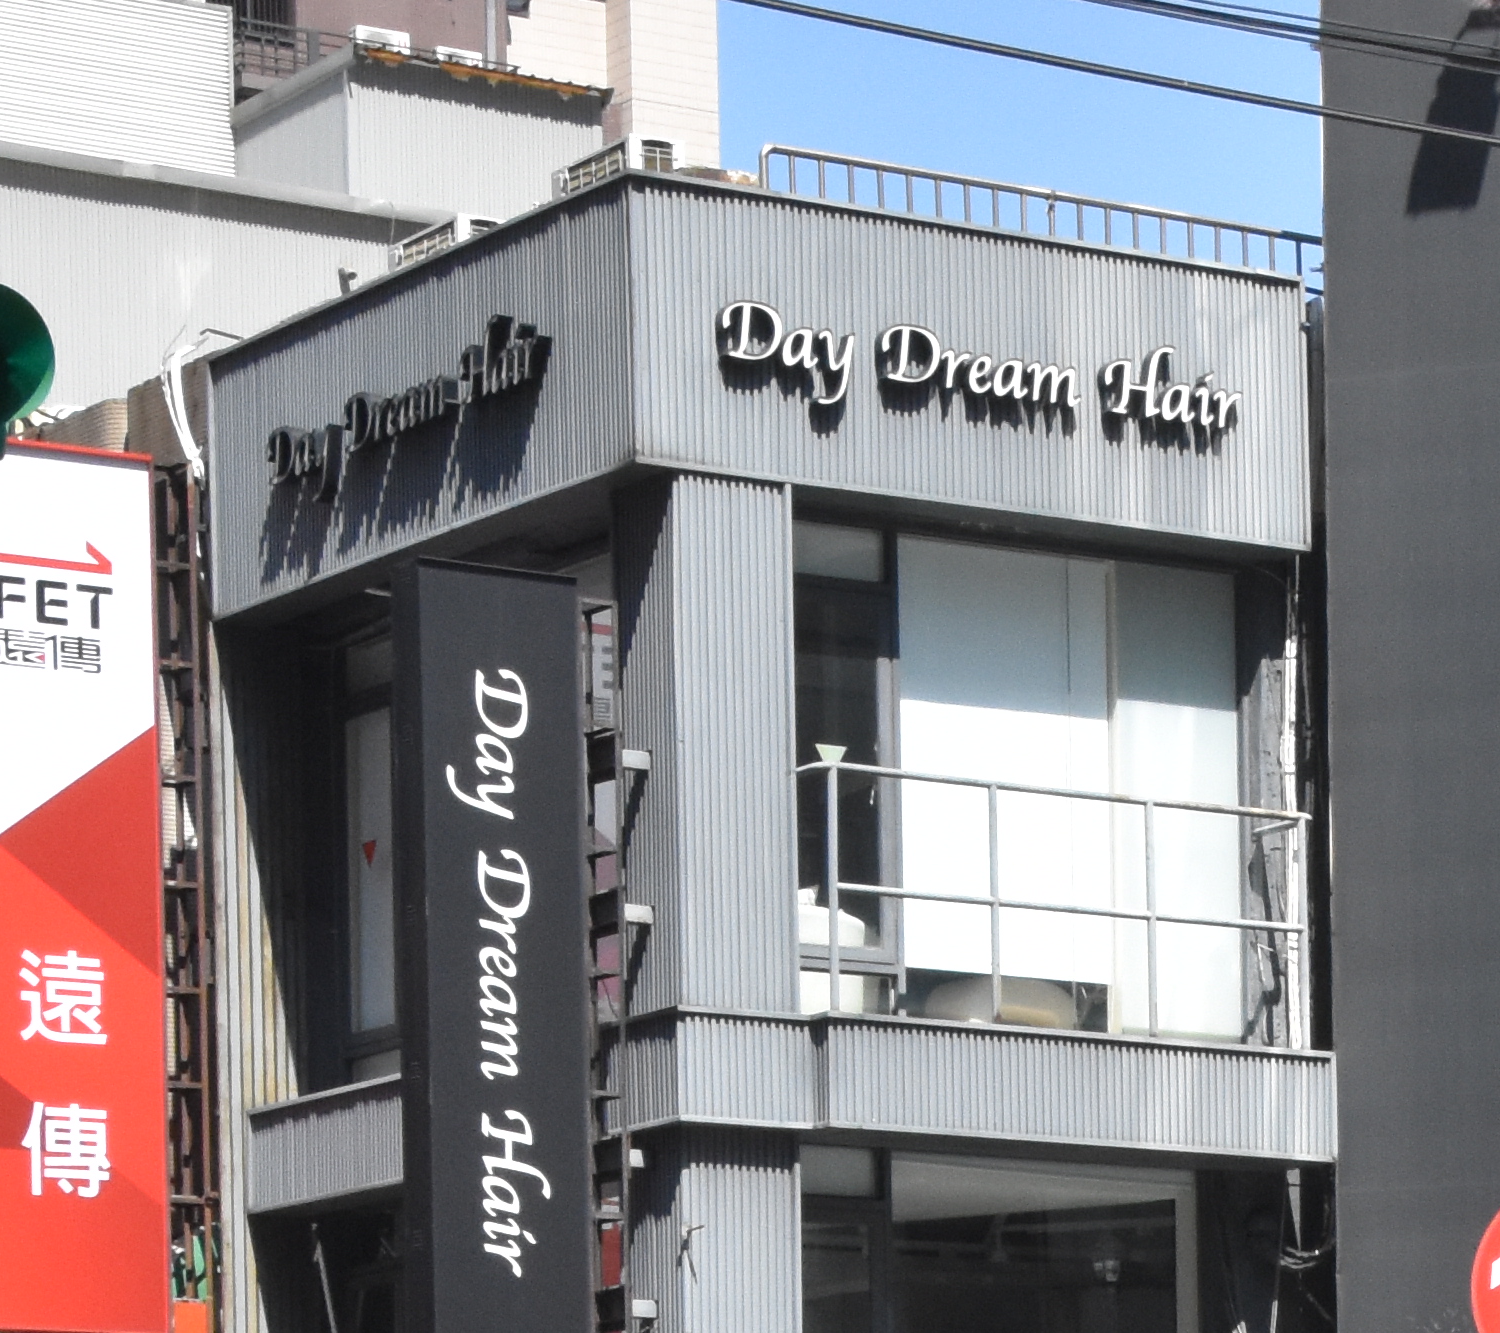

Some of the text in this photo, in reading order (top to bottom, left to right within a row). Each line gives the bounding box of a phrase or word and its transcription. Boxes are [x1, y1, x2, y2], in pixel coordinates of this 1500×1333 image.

[722, 302, 1242, 428] Day Dream Hair
[268, 425, 343, 503] Day
[447, 669, 552, 1279] Day Dream Hair
[20, 950, 110, 1198] 遠傳
